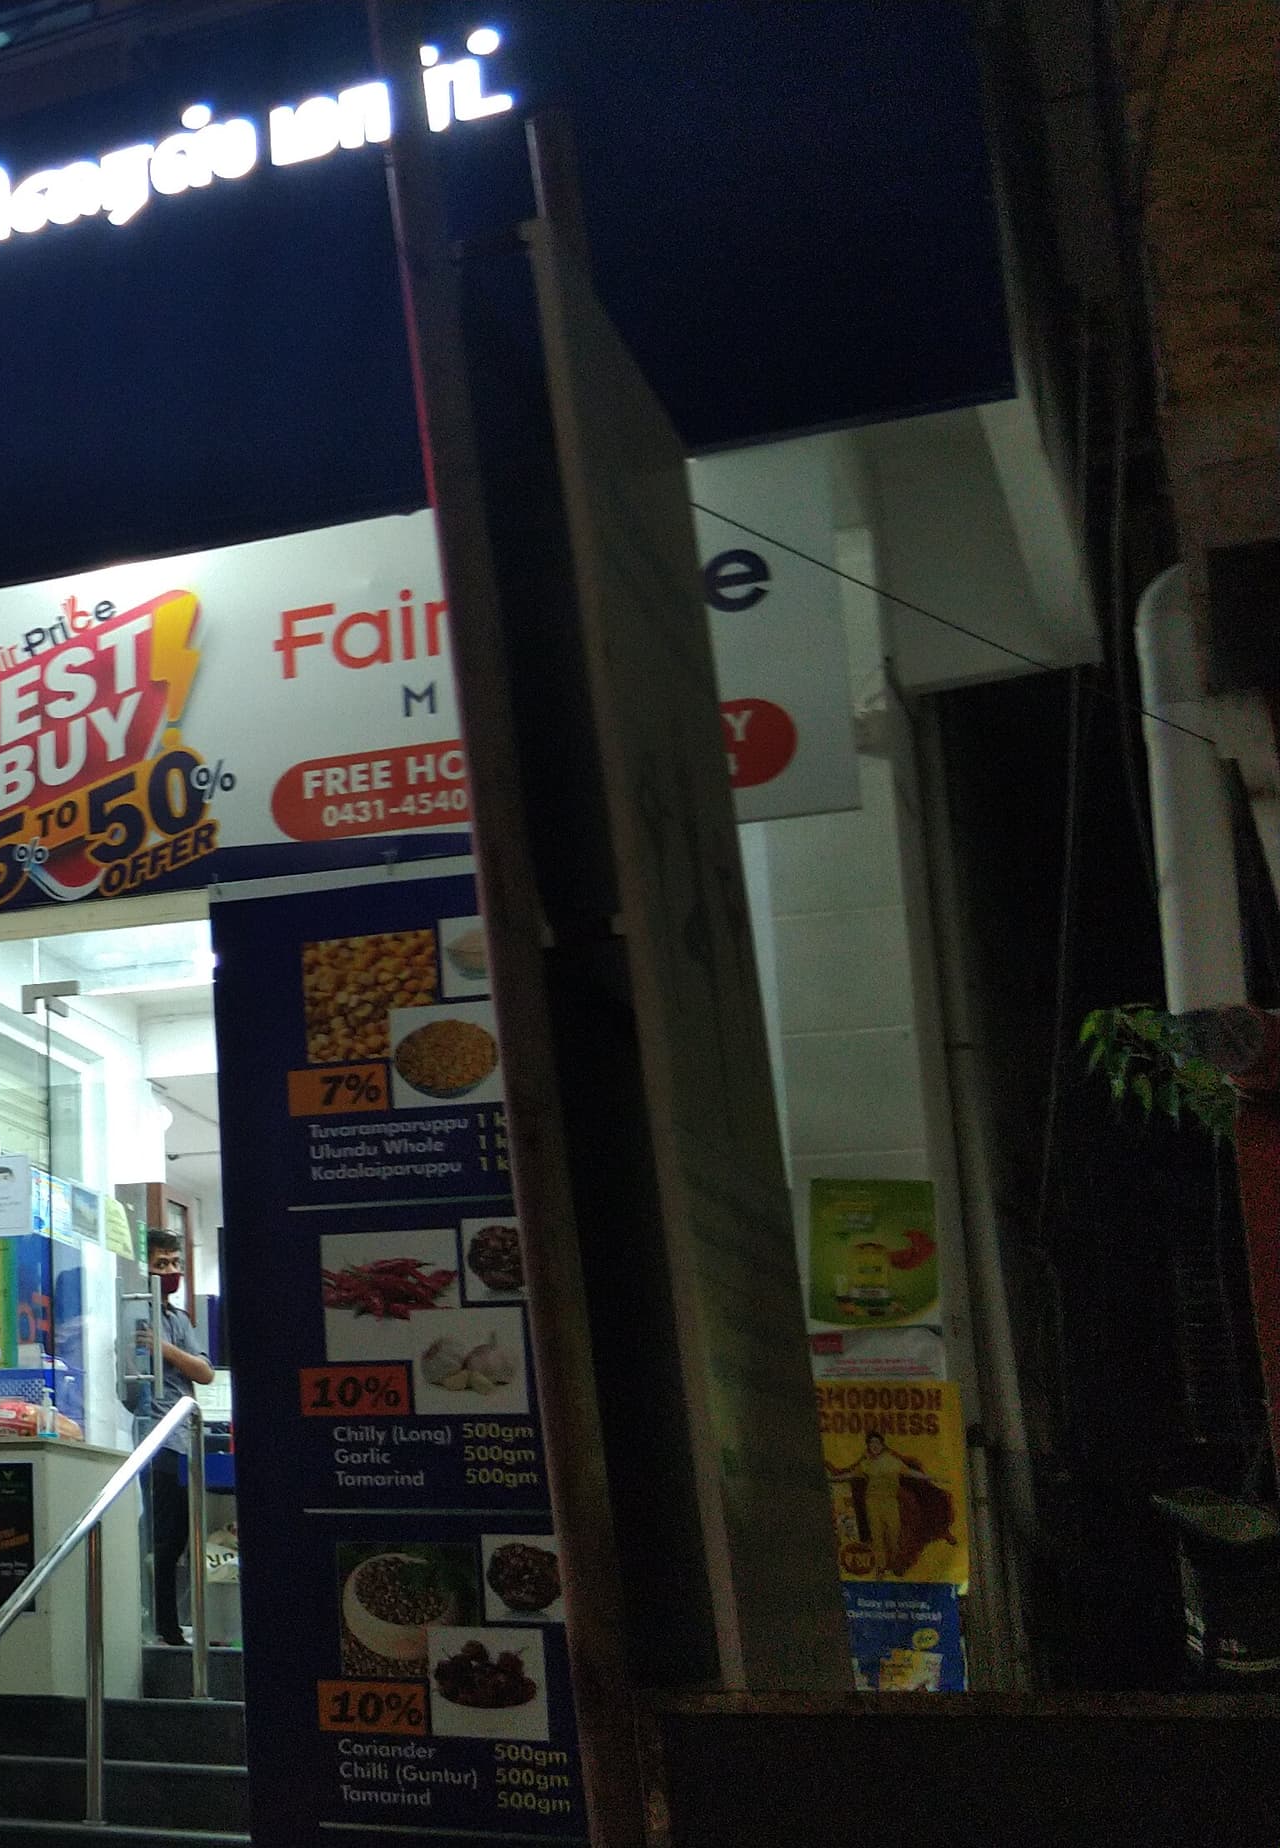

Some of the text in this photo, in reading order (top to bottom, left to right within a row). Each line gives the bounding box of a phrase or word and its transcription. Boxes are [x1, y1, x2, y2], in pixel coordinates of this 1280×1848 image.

[20, 594, 116, 658] Price
[301, 757, 392, 799] FREE
[36, 800, 79, 838] TO
[87, 747, 237, 865] 50%
[99, 820, 218, 898] OFFER
[320, 1071, 382, 1107] 7%
[309, 1142, 379, 1160] Ulundu
[381, 1137, 446, 1156] Whole
[309, 1375, 401, 1408] 10%
[332, 1422, 534, 1446] Chilly (Long) 500gm
[333, 1444, 536, 1465] Garlic 500gm
[334, 1467, 539, 1488] Tamarind 500gm
[329, 1690, 424, 1726] 10%
[337, 1737, 569, 1767] Coriander 500gm
[338, 1760, 570, 1791] Chilli (Guntur) 500gm
[340, 1783, 573, 1815] Tamarind 500gm
